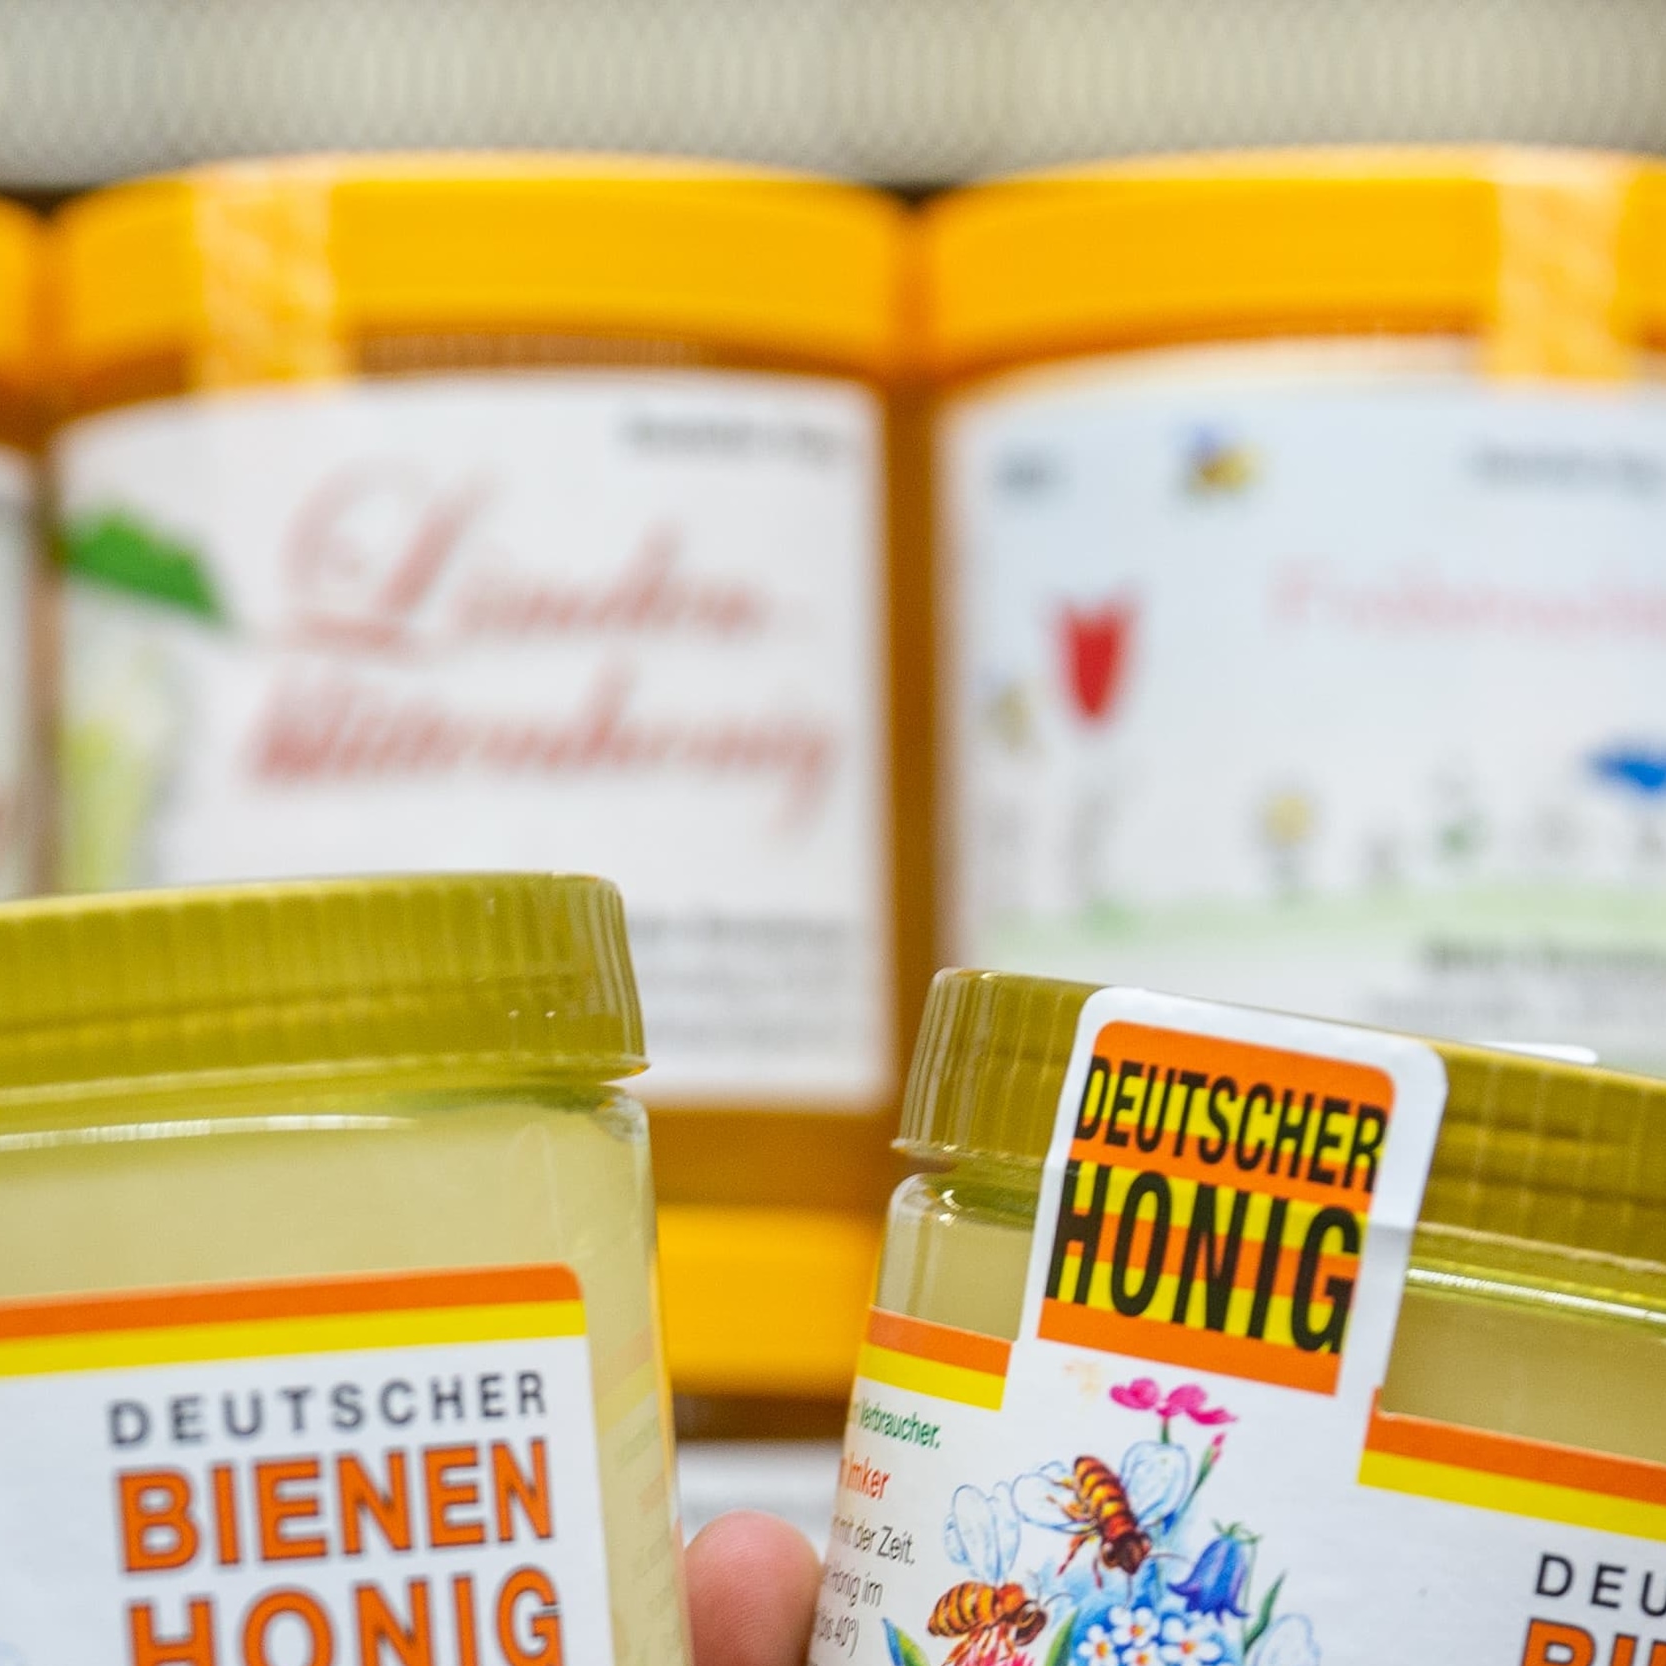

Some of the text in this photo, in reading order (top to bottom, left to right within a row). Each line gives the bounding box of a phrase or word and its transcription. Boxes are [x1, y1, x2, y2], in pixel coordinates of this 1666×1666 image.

[1074, 1055, 1389, 1194] DEUTSCHER
[1044, 1159, 1362, 1356] HONIG
[106, 1370, 547, 1450] DEUTSCHER
[115, 1436, 554, 1573] BIENEN
[877, 1525, 915, 1565] Zeit.
[862, 1571, 883, 1608] im
